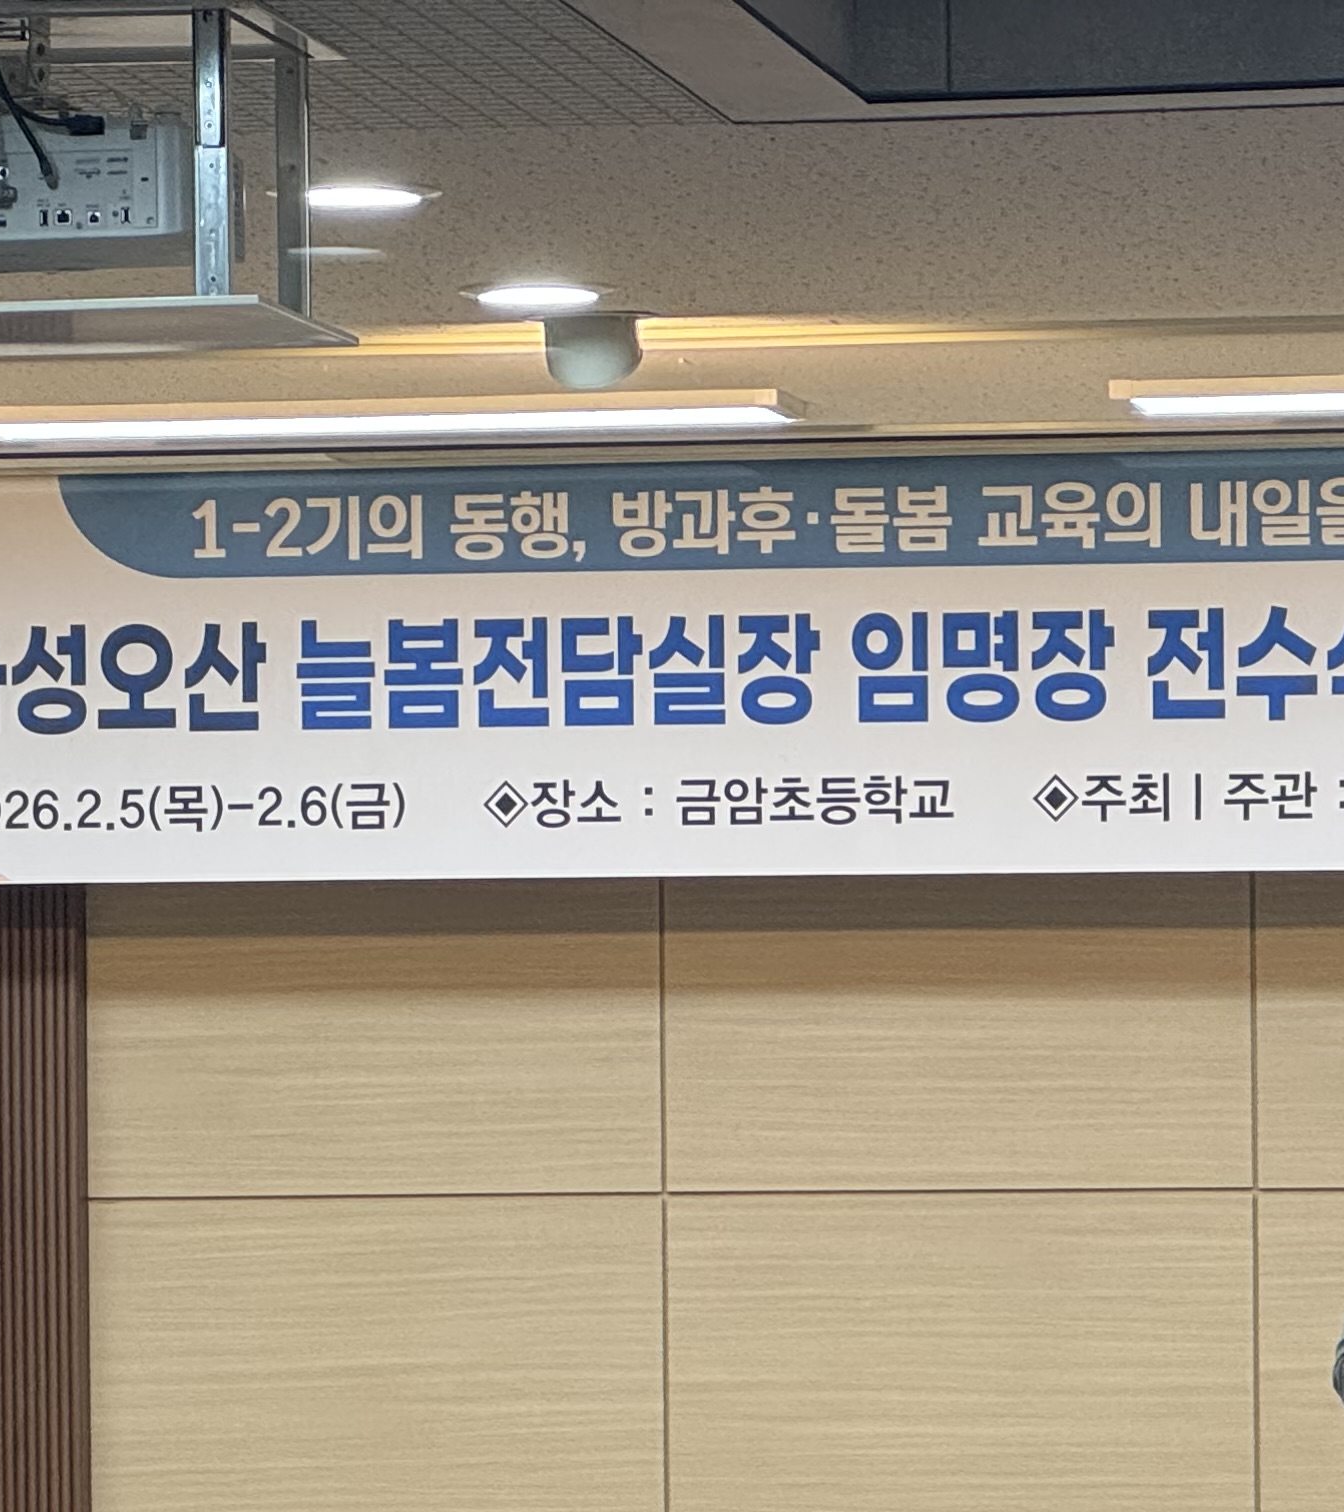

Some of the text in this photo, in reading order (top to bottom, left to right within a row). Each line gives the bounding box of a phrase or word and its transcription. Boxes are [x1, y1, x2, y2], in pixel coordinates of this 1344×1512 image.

[191, 494, 424, 561] 1-2기의
[450, 491, 587, 563] 동행,
[977, 481, 1162, 550] 교육의
[296, 612, 821, 730] 늘봄전담실장
[851, 608, 1115, 723] 임명장
[675, 774, 955, 826] 금암초등학교
[1223, 770, 1318, 821] 주관
